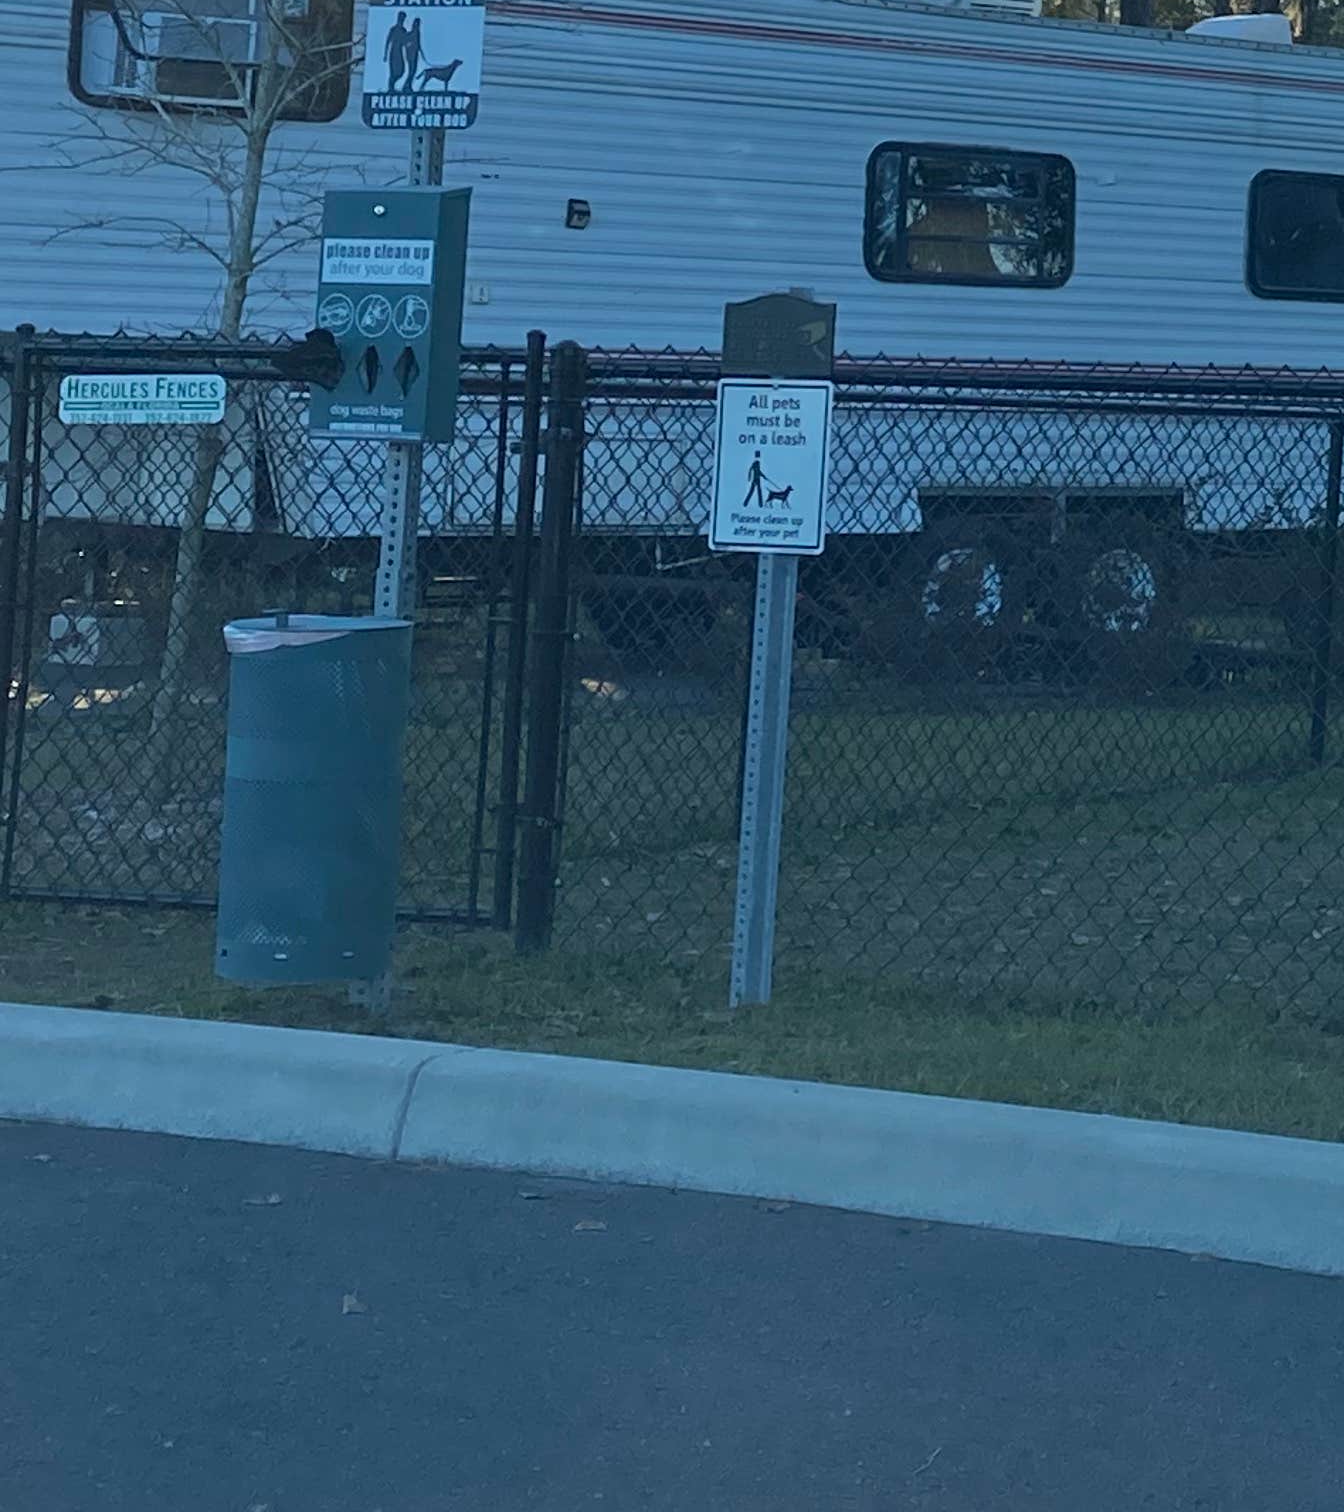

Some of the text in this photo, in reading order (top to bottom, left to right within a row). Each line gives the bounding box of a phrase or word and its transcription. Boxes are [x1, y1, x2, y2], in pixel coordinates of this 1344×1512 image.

[371, 95, 471, 110] PLEASE CLEAN UP
[371, 113, 467, 127] AFTER YOUR DOG
[326, 243, 430, 260] please clean up
[329, 260, 425, 279] after your dog
[67, 376, 219, 399] HERCULES FENCES
[329, 403, 350, 418] dog
[380, 404, 404, 419] bags
[749, 395, 801, 413] All pets
[746, 414, 801, 428] must be
[738, 431, 807, 446] on a leash
[731, 512, 804, 527] Please clean up
[733, 526, 799, 540] after your pet
